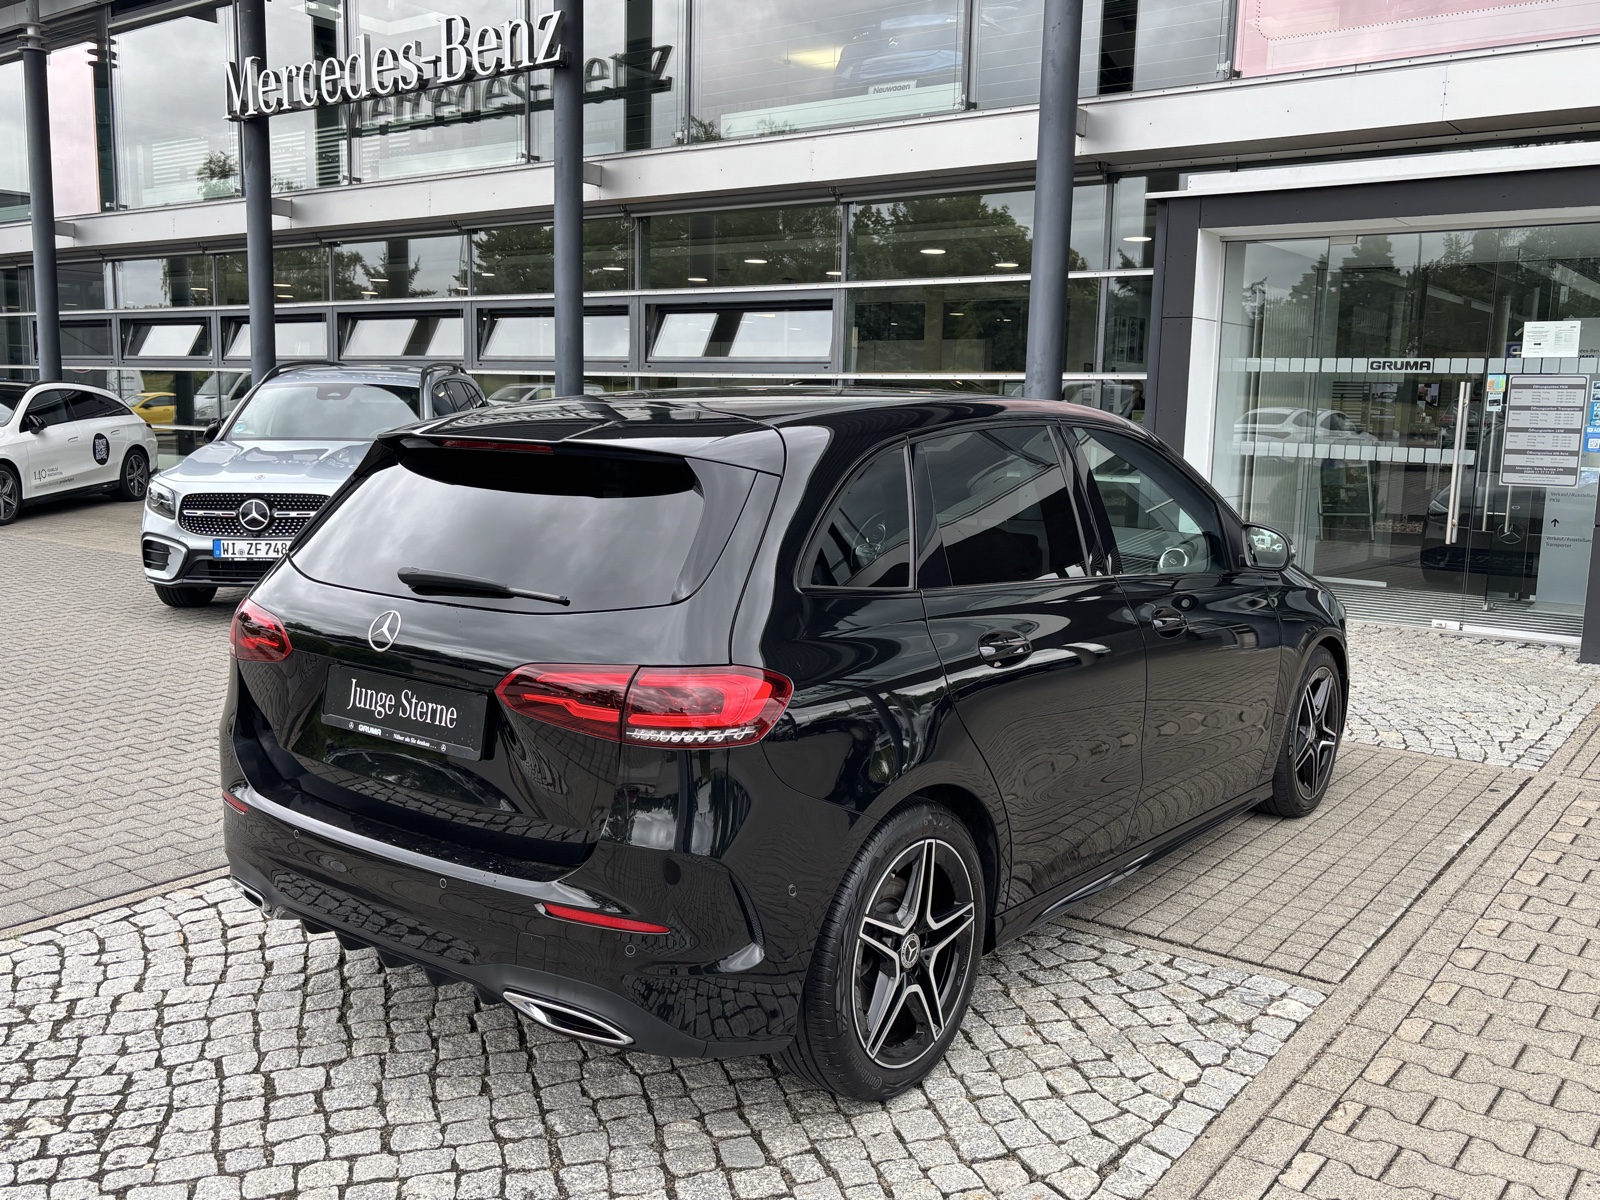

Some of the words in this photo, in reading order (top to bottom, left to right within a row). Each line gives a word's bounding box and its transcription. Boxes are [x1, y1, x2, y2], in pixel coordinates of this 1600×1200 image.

[222, 10, 566, 120] Mercedes-Benz
[1370, 360, 1431, 371] GRUMA
[33, 468, 47, 482] 140
[222, 542, 236, 556] WI
[246, 542, 262, 556] ZF
[347, 678, 395, 719] Junge
[399, 689, 457, 729] Sterne
[358, 724, 382, 736] GRUMA
